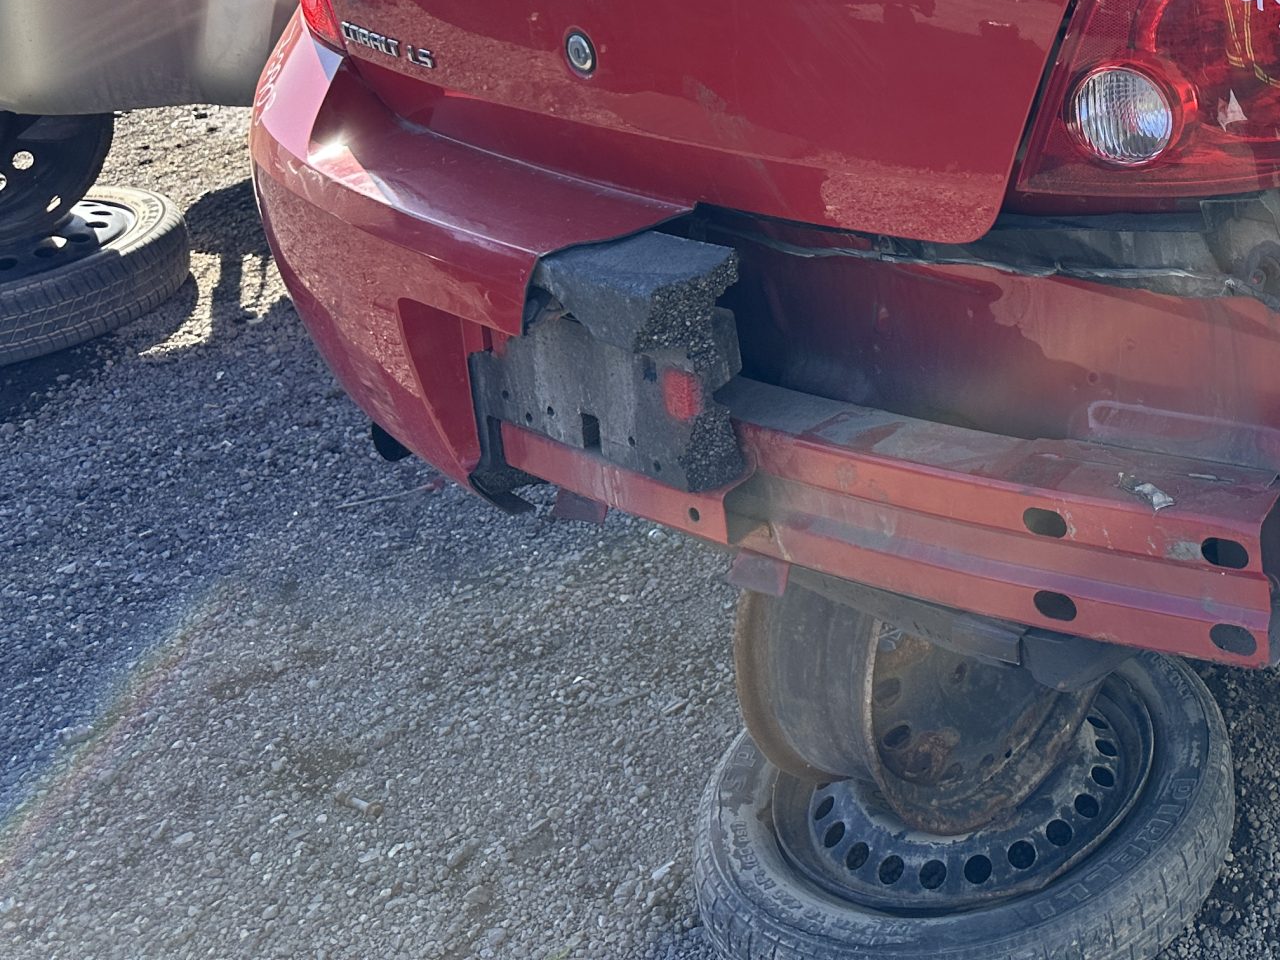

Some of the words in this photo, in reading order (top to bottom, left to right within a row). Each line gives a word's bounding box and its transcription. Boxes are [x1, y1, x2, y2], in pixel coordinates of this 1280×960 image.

[340, 21, 400, 58] COBALT
[407, 44, 435, 69] LS
[1033, 777, 1199, 921] PIRELLI
